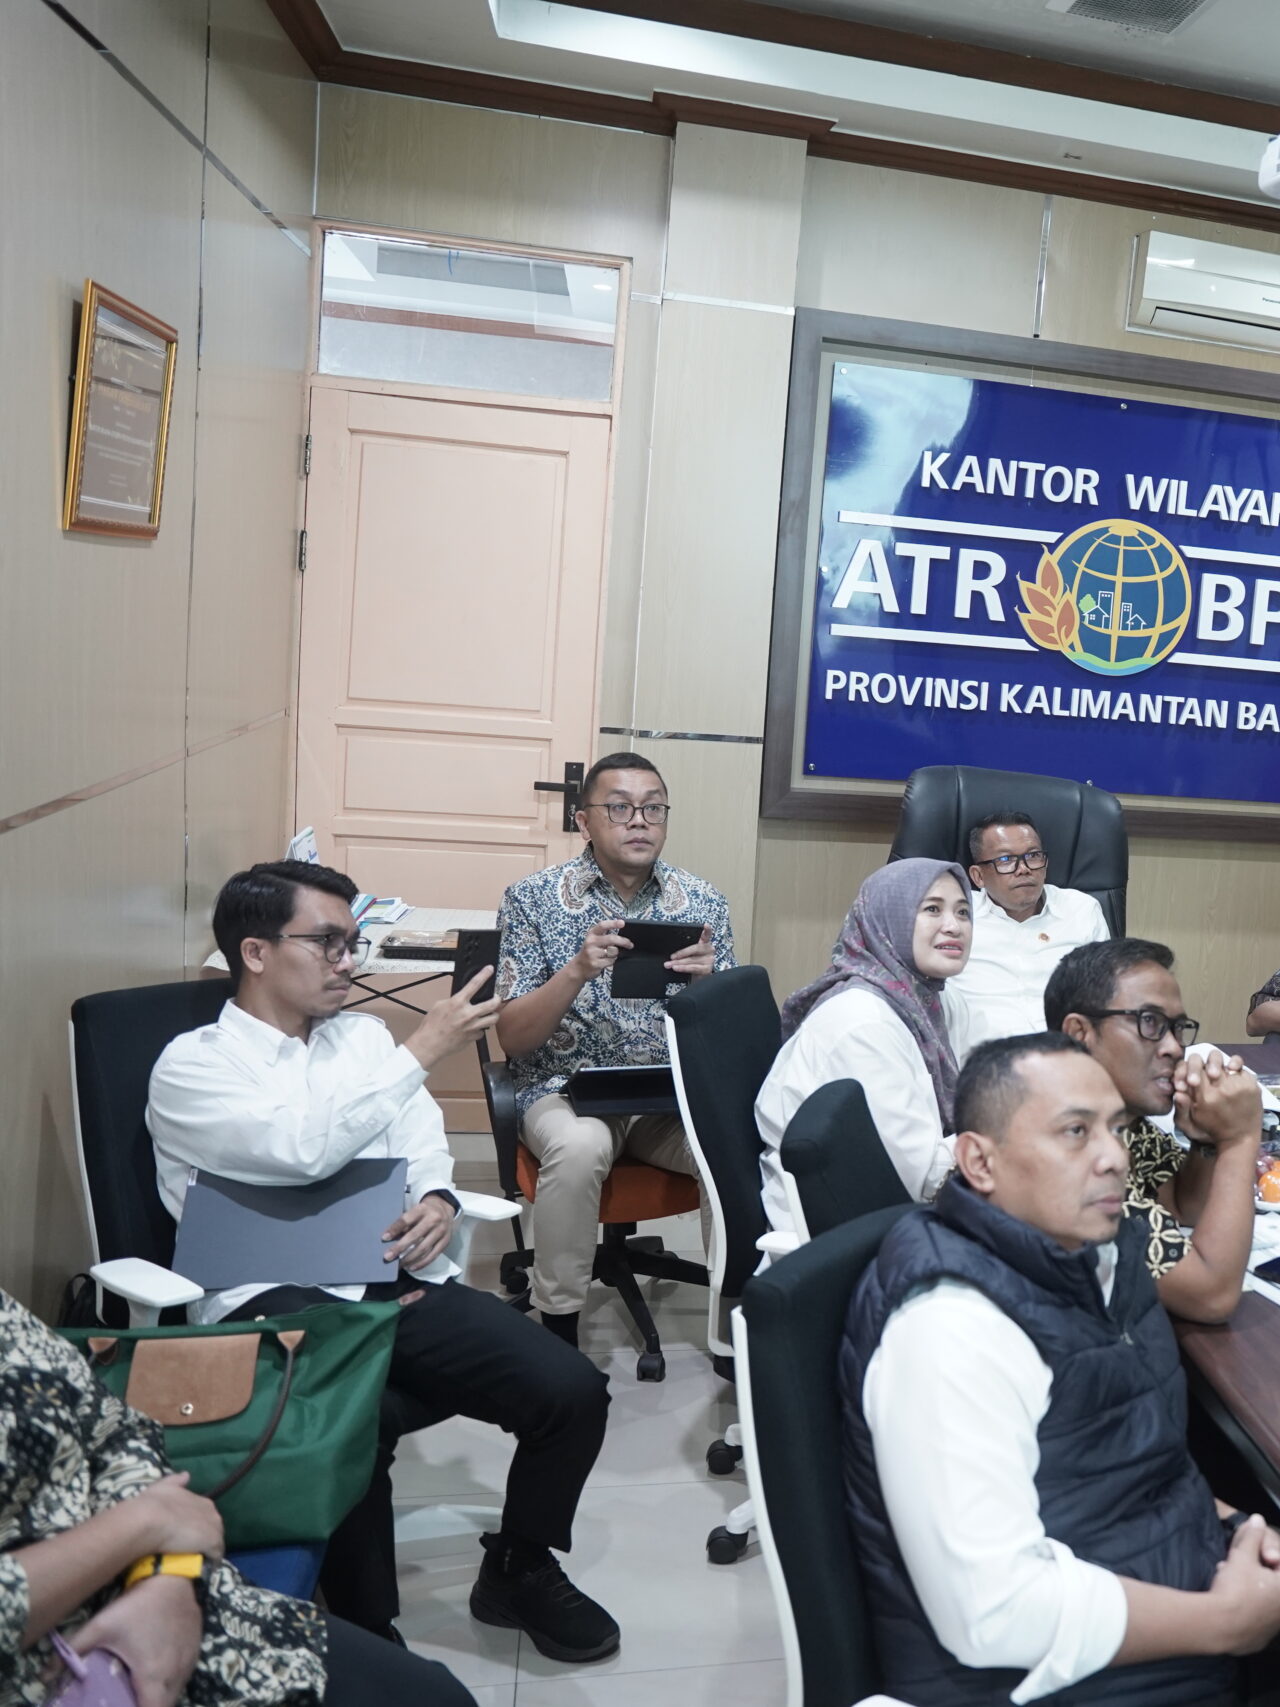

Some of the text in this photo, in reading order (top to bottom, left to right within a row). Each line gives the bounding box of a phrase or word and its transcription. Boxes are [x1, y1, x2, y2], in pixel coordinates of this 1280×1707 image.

[920, 450, 1100, 506] KANTOR
[831, 538, 1007, 622] ATR
[825, 669, 989, 711] PROVINSI
[1000, 683, 1229, 728] KALIMANTAN
